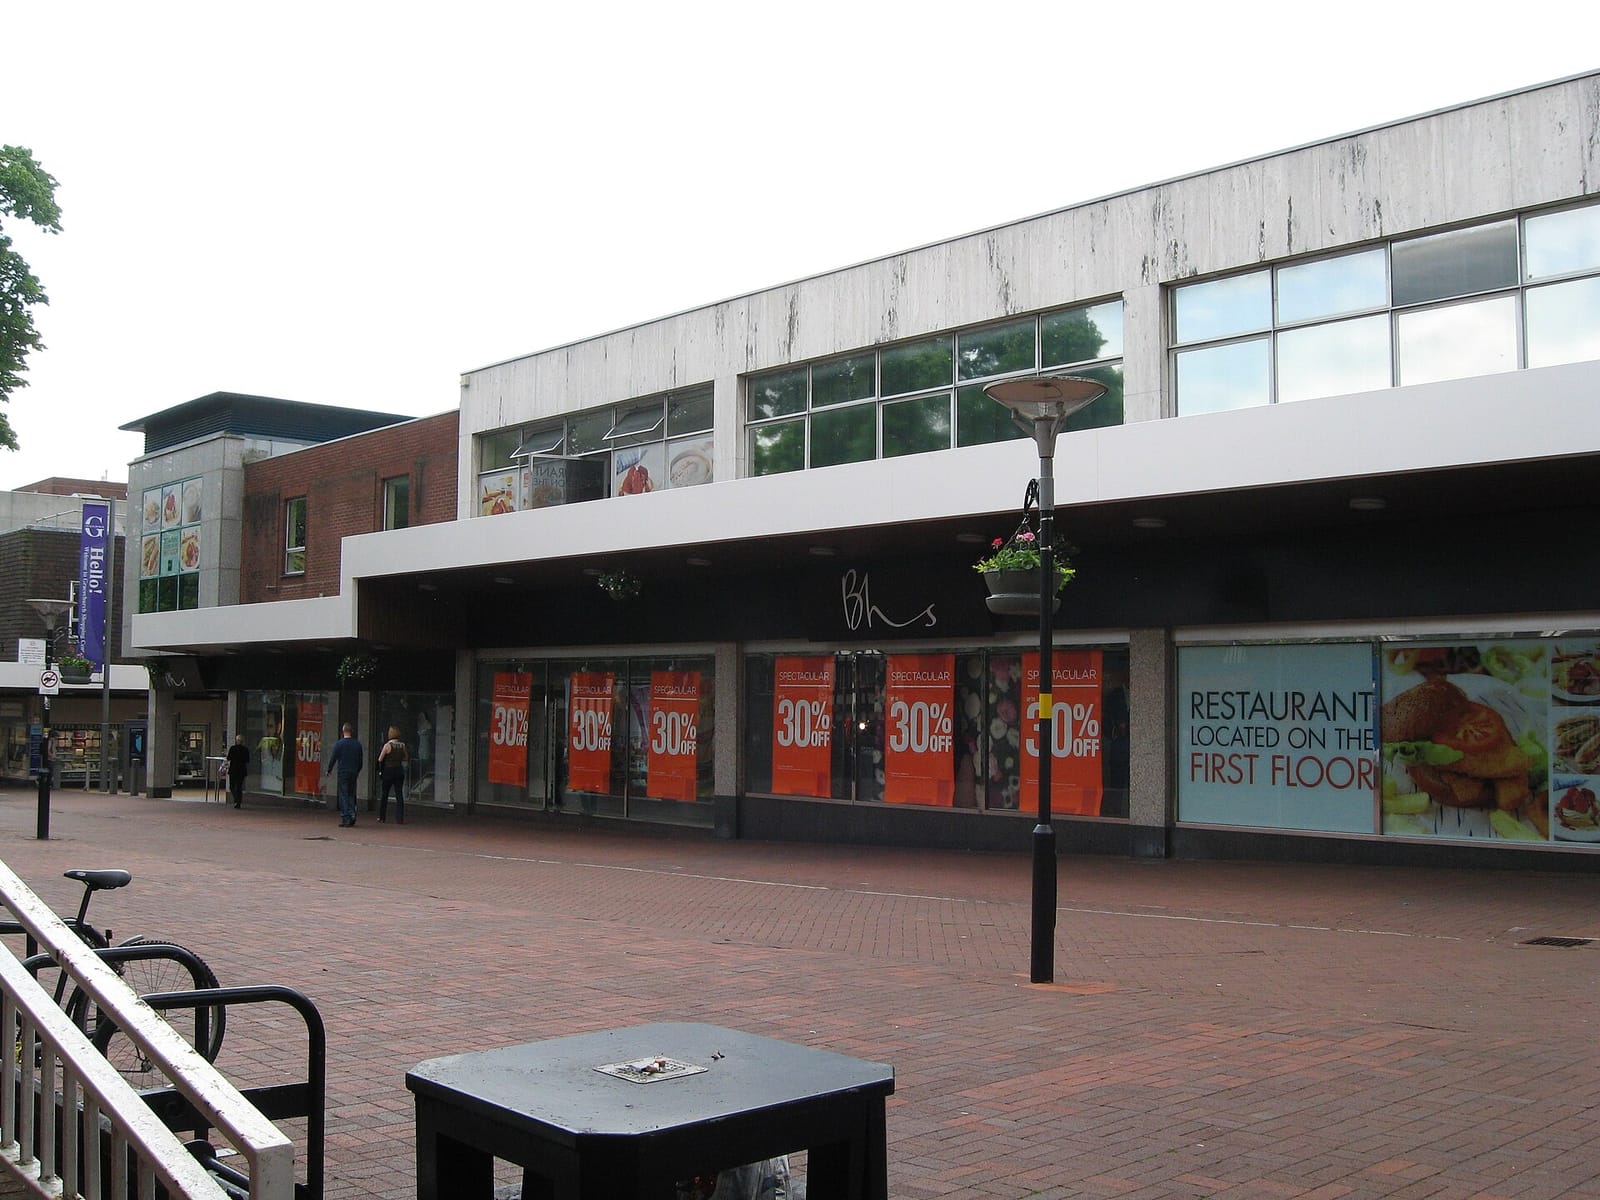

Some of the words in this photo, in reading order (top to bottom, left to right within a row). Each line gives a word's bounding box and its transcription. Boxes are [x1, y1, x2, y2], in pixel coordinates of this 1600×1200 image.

[89, 547, 104, 594] Hello!
[842, 569, 936, 630] Bhs
[779, 672, 829, 681] SPECTACULAR
[891, 672, 950, 681] SPECTACULAR
[1027, 669, 1097, 680] SPTACULAR
[654, 686, 697, 695] SPECTACULAR
[1191, 691, 1374, 722] RESTAURANT
[493, 707, 528, 747] 30%
[573, 709, 611, 751] 30%
[652, 711, 697, 755] 30%
[777, 699, 830, 747] 30%
[889, 701, 952, 753] 30%
[515, 733, 528, 747] OFF
[598, 737, 611, 751] OFF
[681, 741, 697, 755] OFF
[811, 731, 830, 747] OFF
[929, 735, 952, 753] OFF
[1073, 739, 1099, 757] OFF
[1191, 726, 1279, 748] LOCATED
[1288, 727, 1326, 749] ON
[1335, 728, 1374, 750] THE
[1191, 752, 1259, 784] FIRST
[1272, 755, 1375, 790] FLOOR
